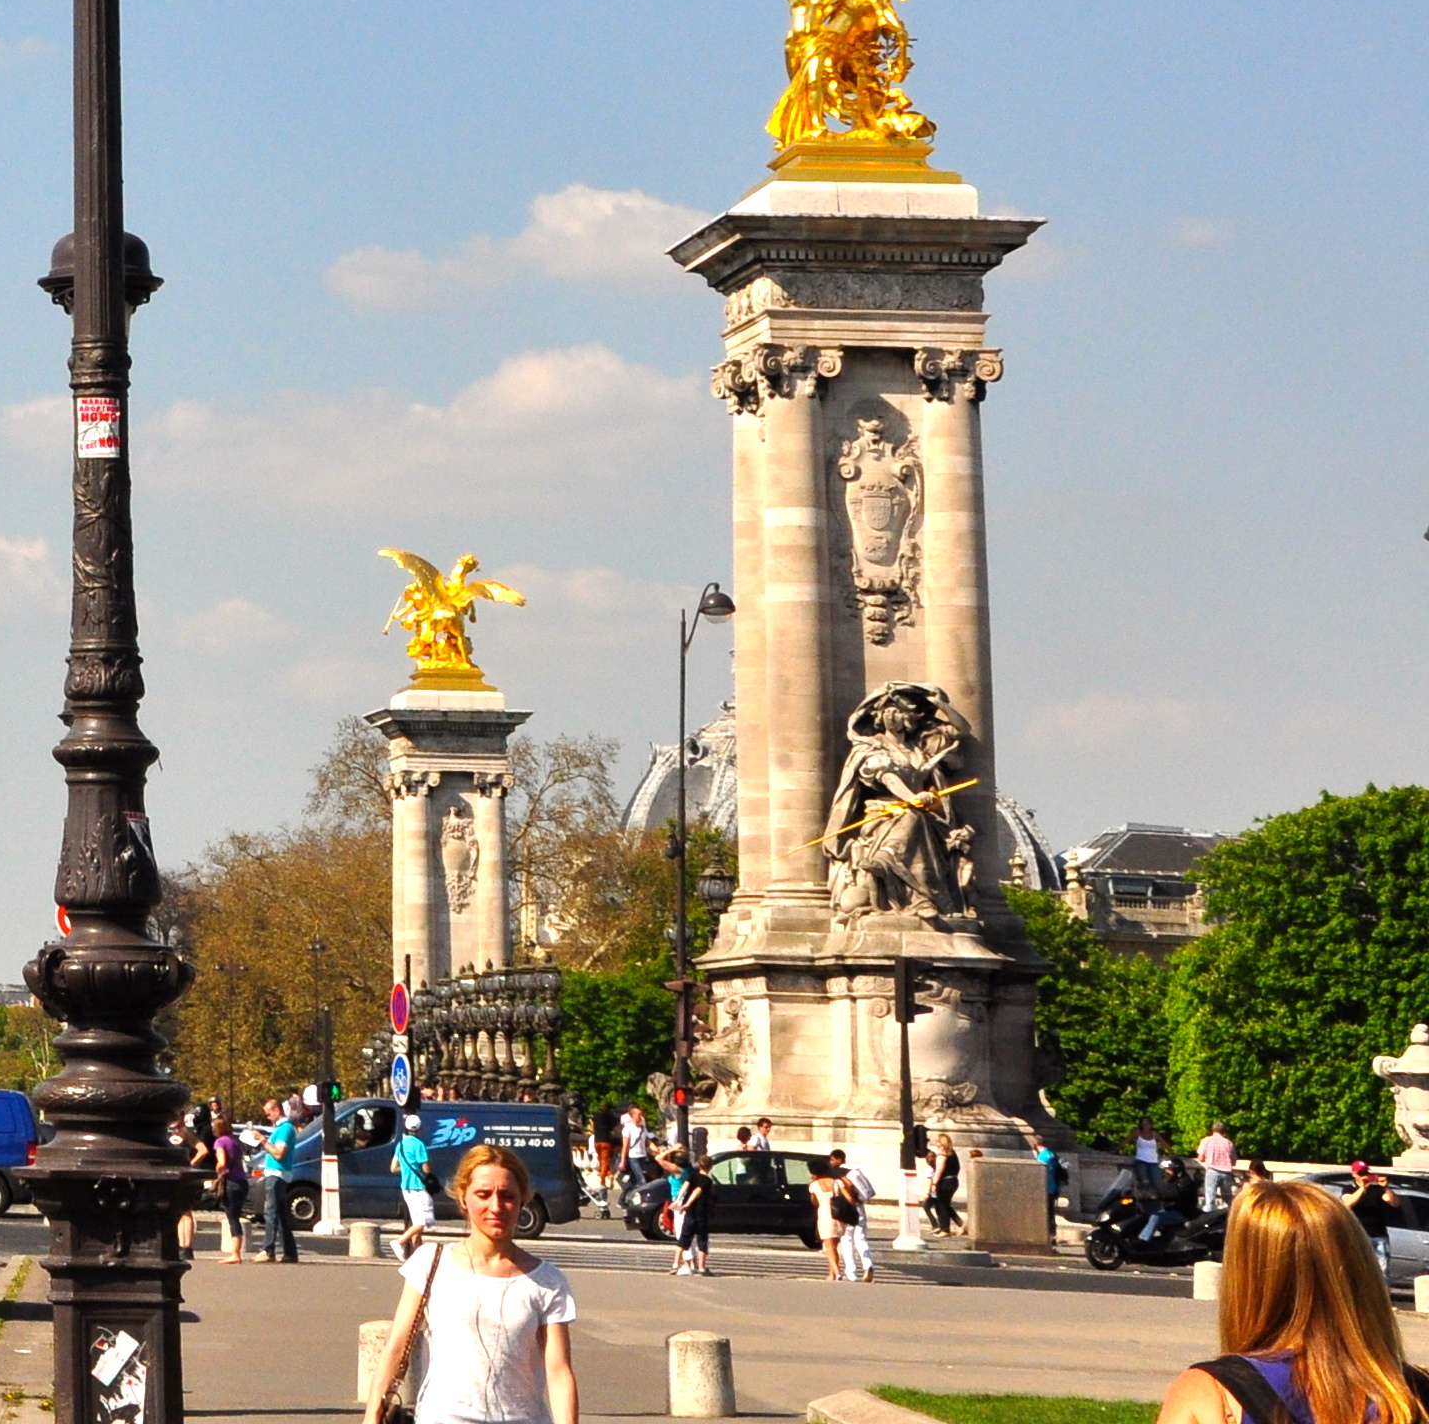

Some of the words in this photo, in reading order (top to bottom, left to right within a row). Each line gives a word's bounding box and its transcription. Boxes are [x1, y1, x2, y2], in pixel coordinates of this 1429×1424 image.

[81, 412, 118, 422] HOMO
[484, 1137, 496, 1145] 01
[498, 1137, 511, 1146] 55
[514, 1138, 526, 1147] 26
[528, 1138, 541, 1147] 40
[542, 1138, 556, 1147] 00
